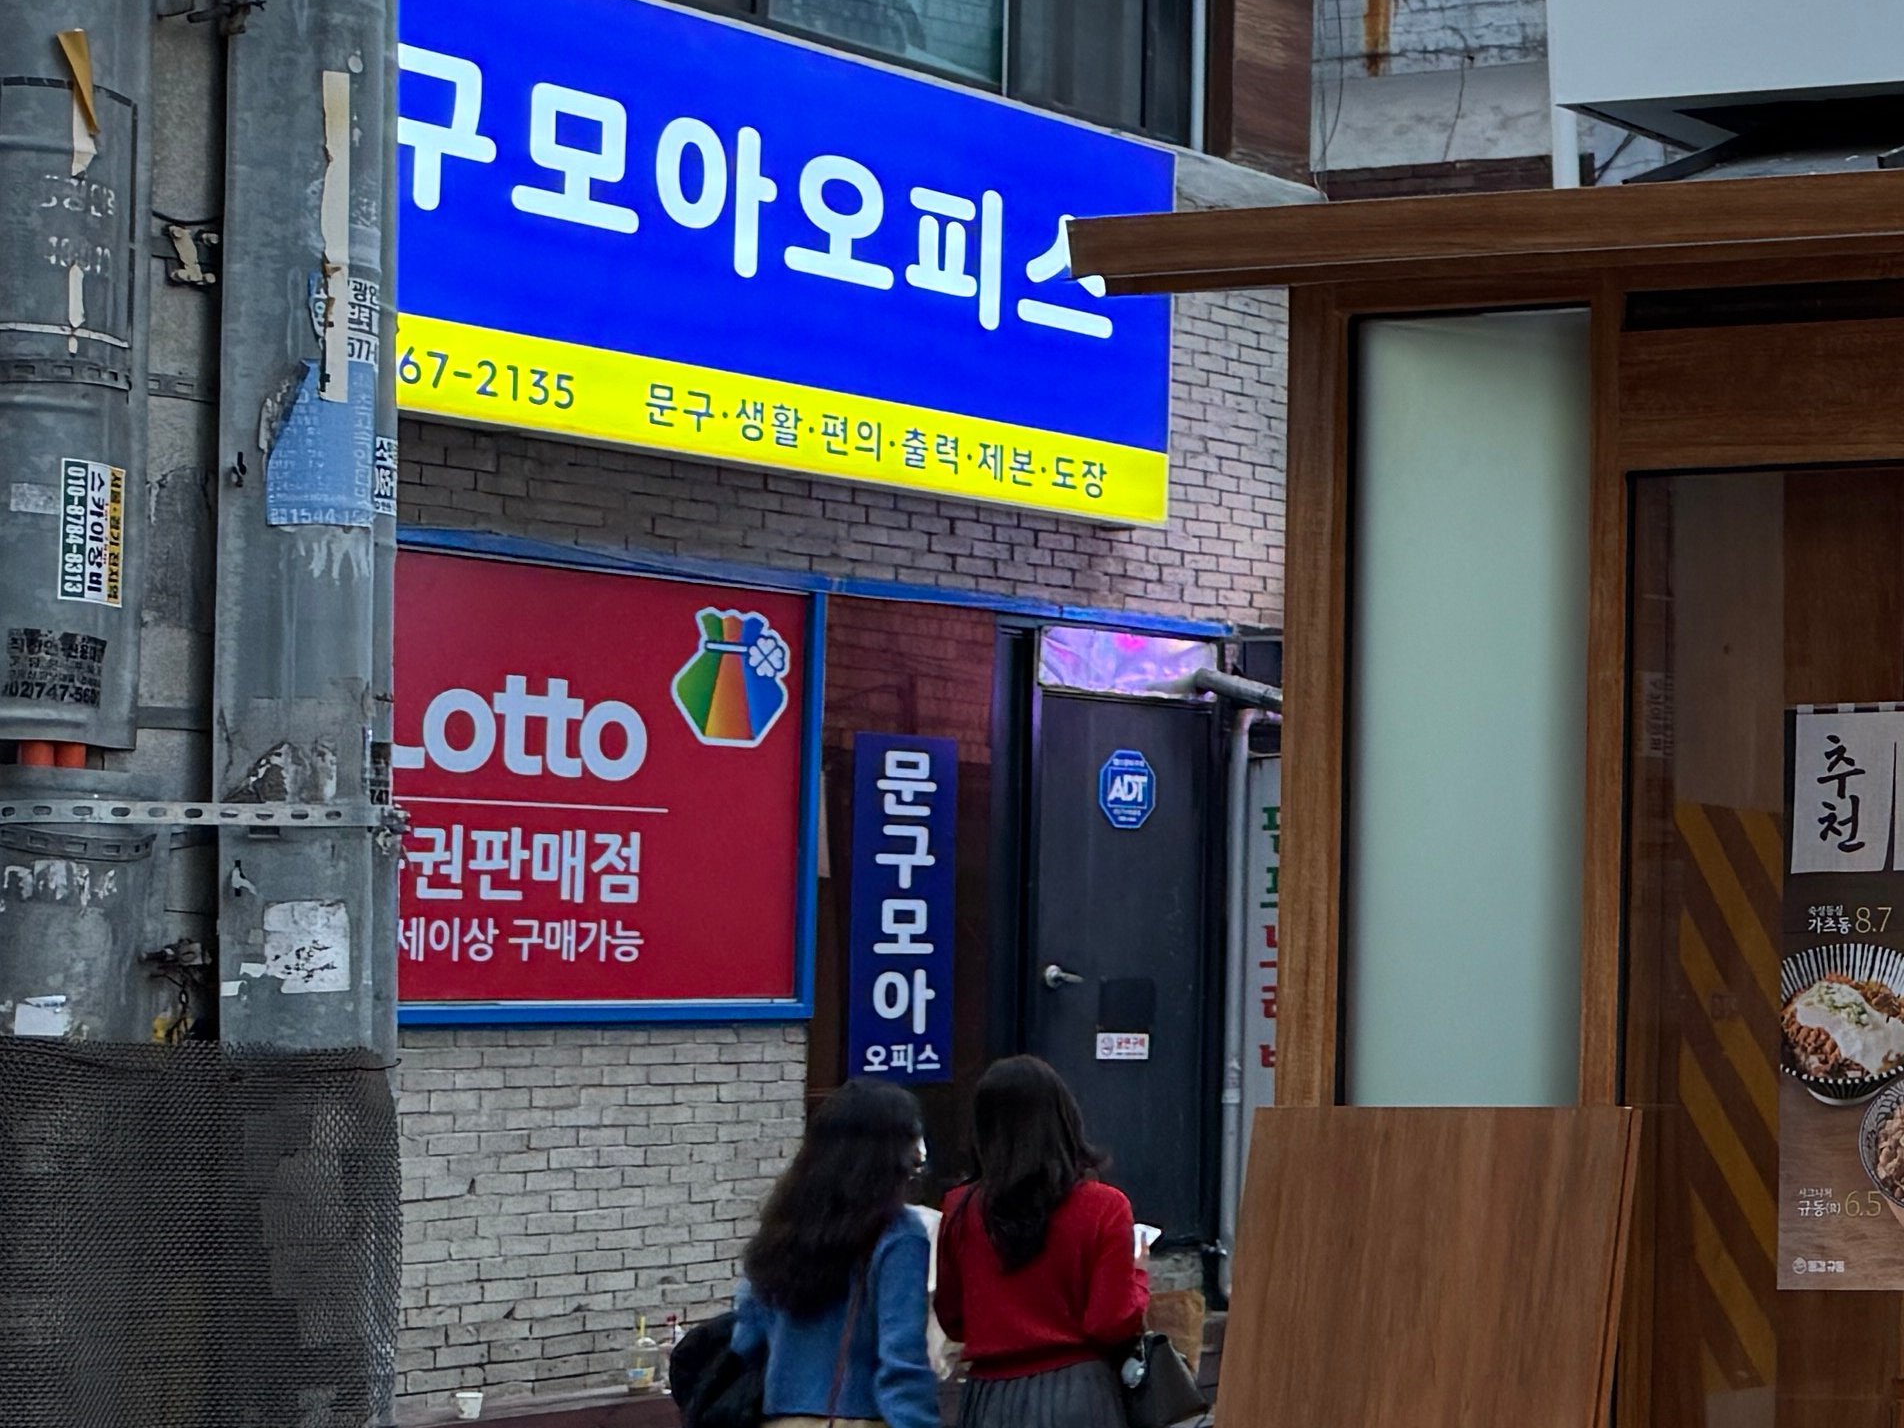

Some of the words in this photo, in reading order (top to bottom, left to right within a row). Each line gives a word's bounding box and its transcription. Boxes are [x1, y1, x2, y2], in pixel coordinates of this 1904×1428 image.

[63, 465, 87, 595] 010-8784-8313
[87, 471, 106, 594] 스카이장비
[1107, 774, 1148, 803] ADT
[1816, 732, 1867, 854] 추천
[398, 824, 642, 904] 권판매점
[873, 749, 938, 1035] 문구모아
[508, 918, 644, 963] 구매가능
[1807, 916, 1852, 934] 가츠동
[1855, 906, 1893, 934] 8.7
[863, 1043, 941, 1073] 오피스
[1844, 1190, 1882, 1218] 6.5
